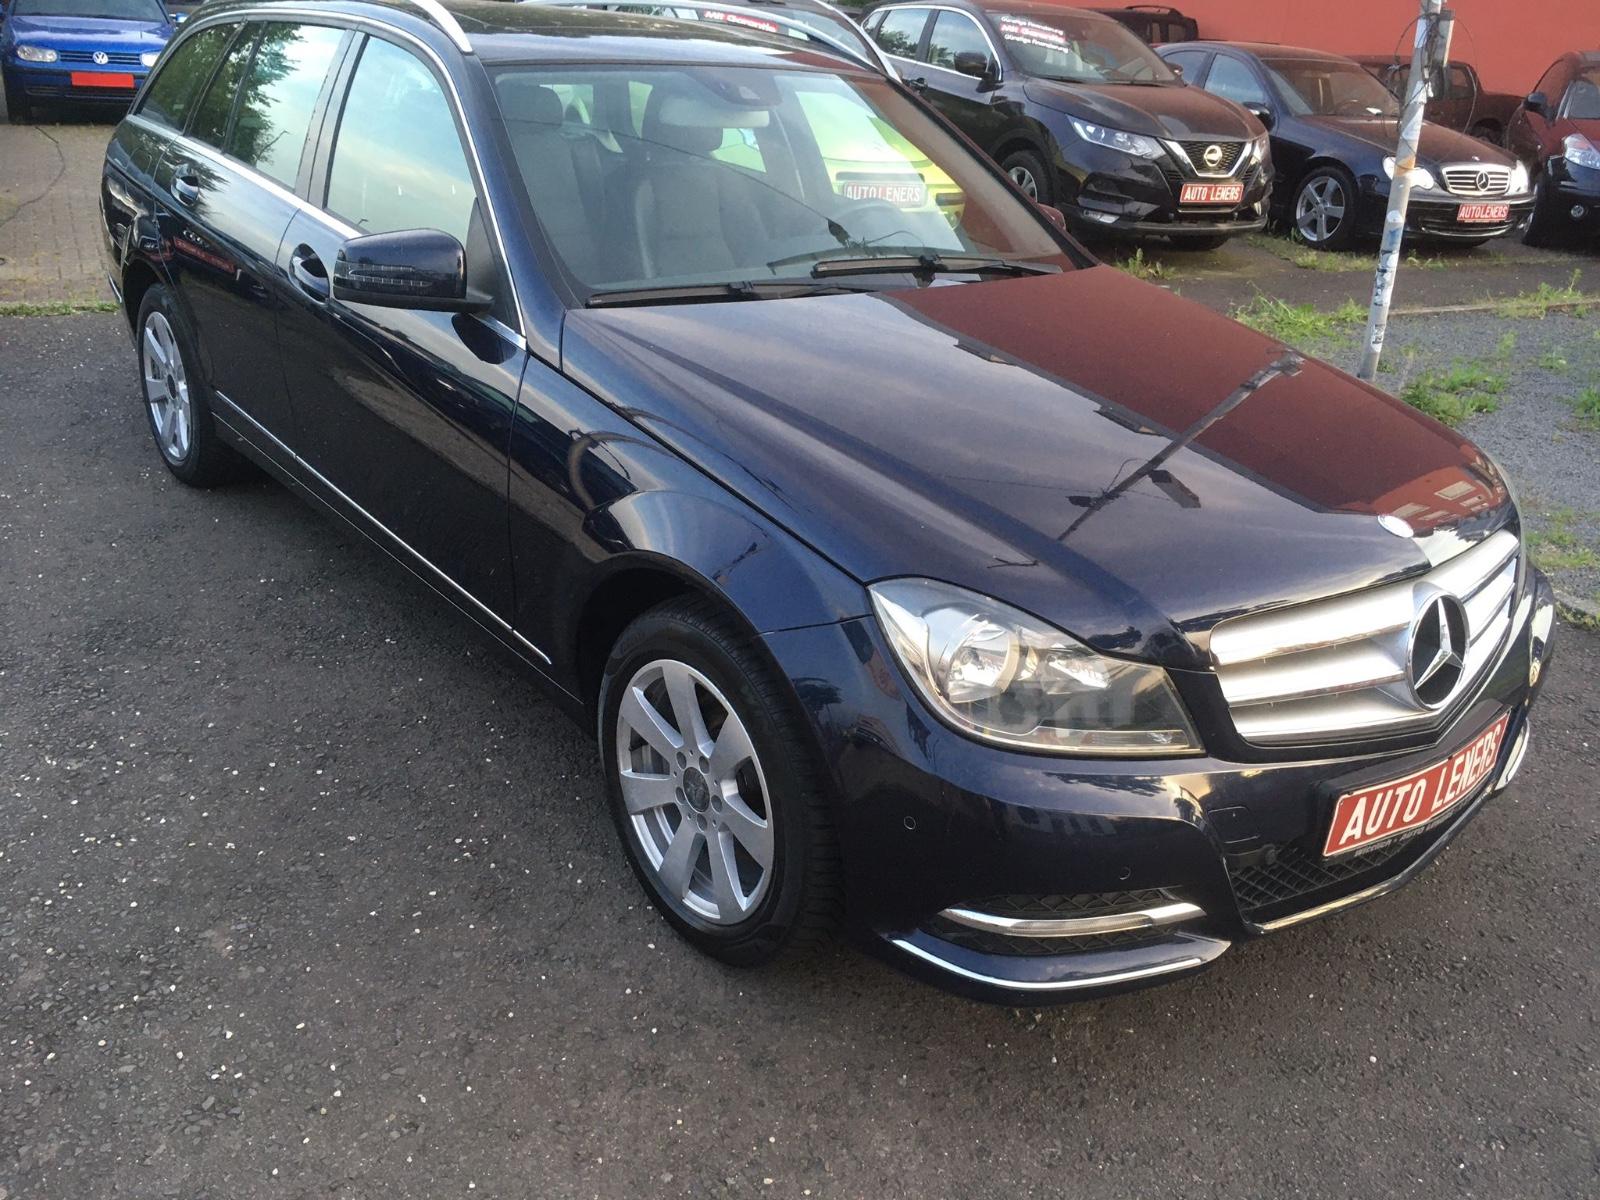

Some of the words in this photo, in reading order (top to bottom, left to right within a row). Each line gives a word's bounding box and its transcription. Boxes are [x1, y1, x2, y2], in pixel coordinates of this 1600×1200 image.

[1184, 186, 1208, 200] AUTO
[1210, 186, 1240, 200] LENERS
[1339, 778, 1427, 845] AUTO
[1431, 724, 1501, 812] LENERS
